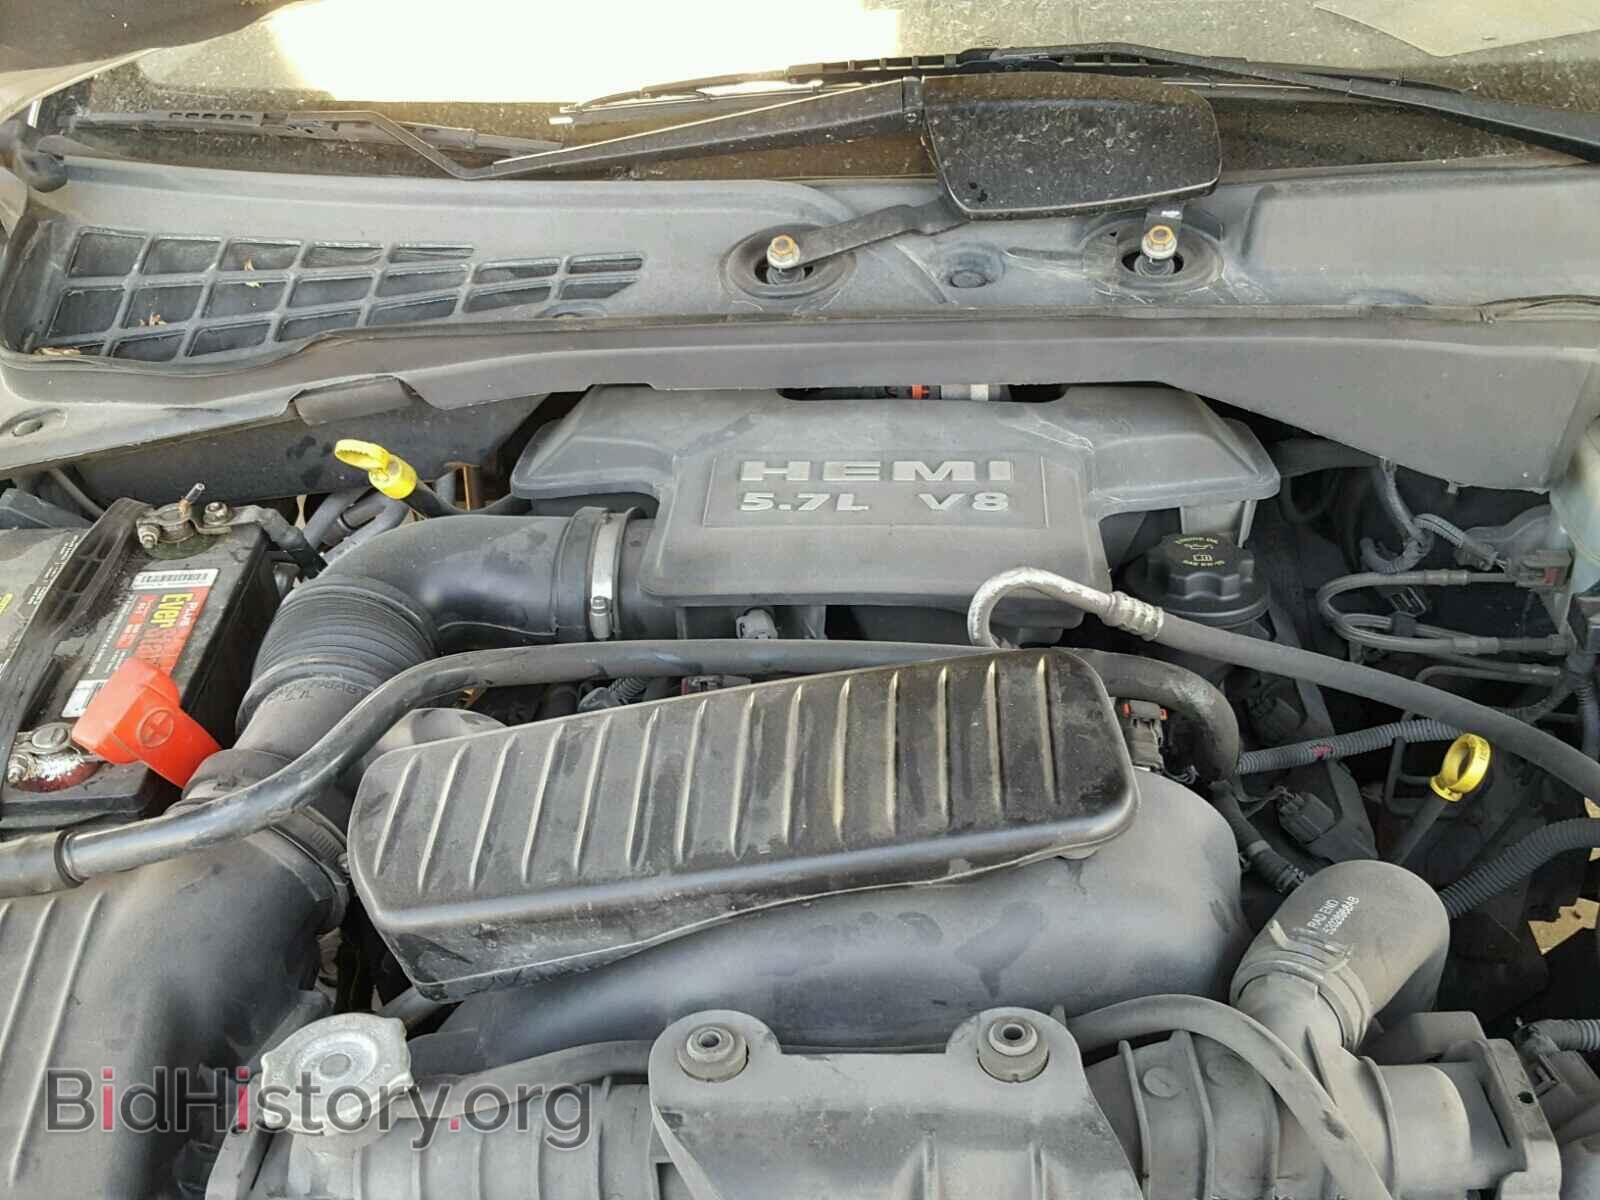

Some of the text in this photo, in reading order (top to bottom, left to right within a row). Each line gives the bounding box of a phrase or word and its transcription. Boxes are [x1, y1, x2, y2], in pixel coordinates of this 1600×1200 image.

[740, 461, 1013, 481] HEMI
[740, 492, 1009, 512] 5.7L V8
[1319, 899, 1339, 915] END
